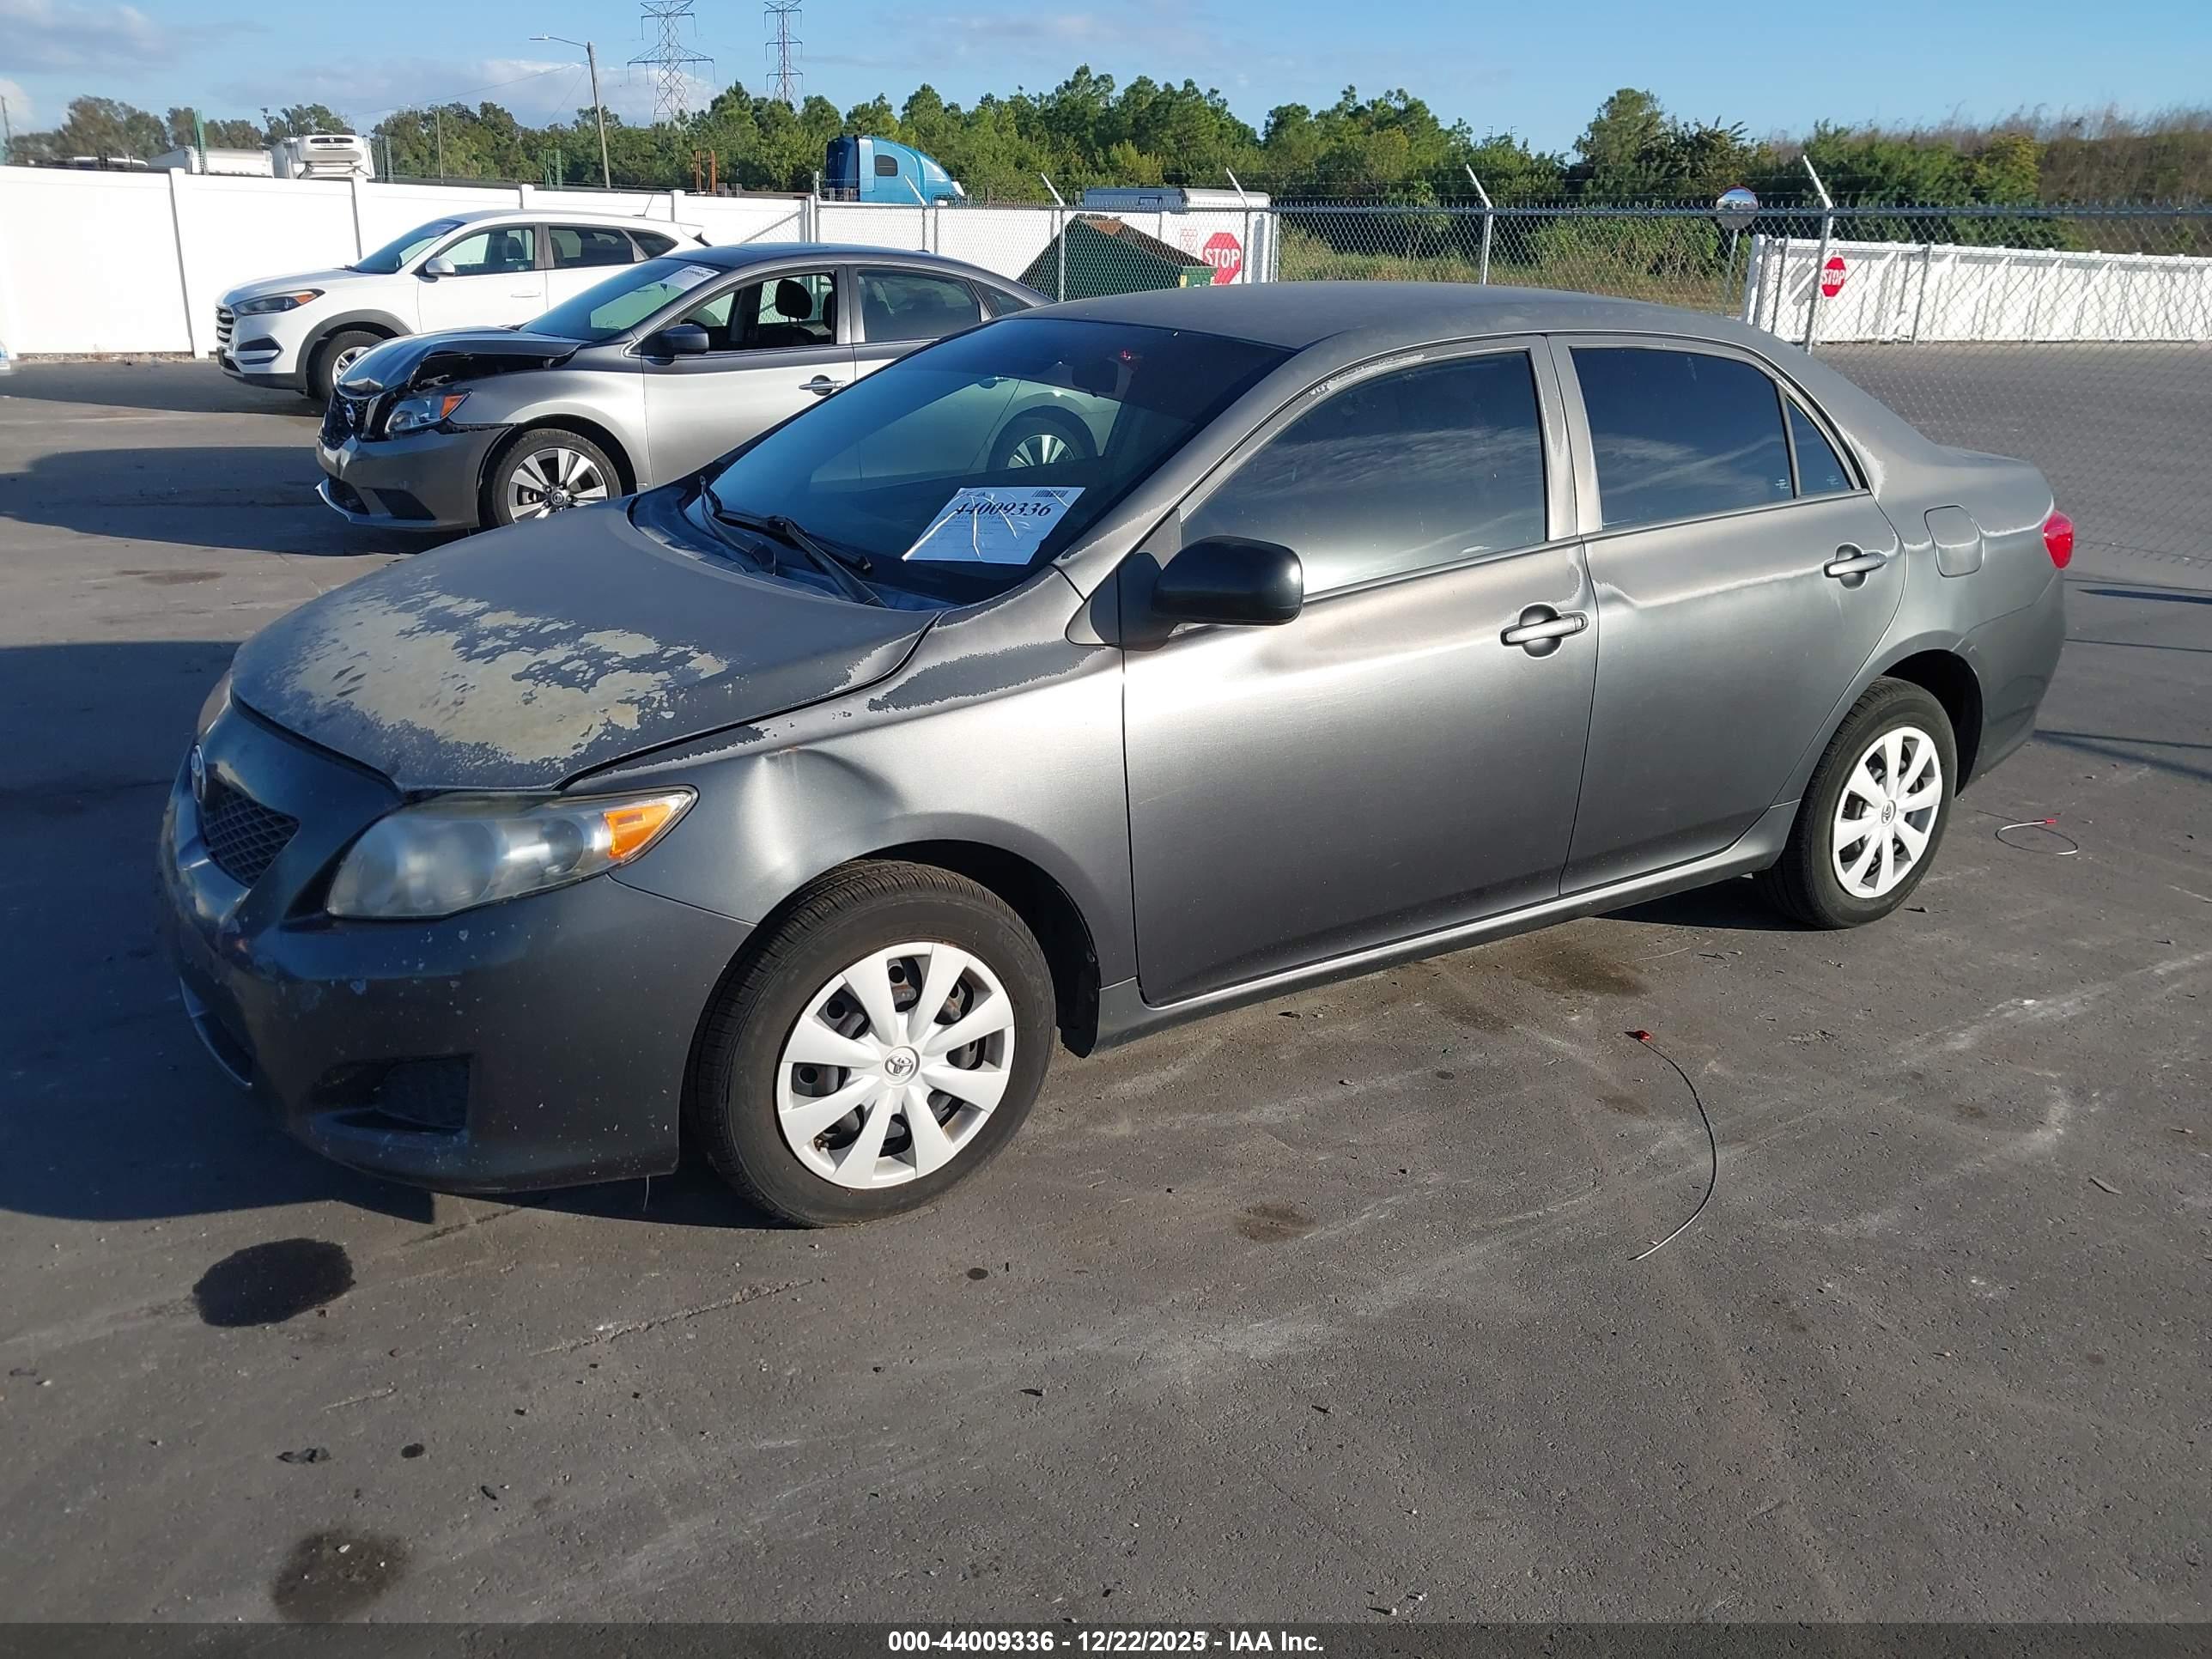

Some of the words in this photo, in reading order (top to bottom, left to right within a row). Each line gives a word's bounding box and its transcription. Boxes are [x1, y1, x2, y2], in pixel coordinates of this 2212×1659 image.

[1204, 247, 1241, 269] STOP
[1822, 269, 1845, 285] STOP
[956, 501, 1058, 517] 44009336
